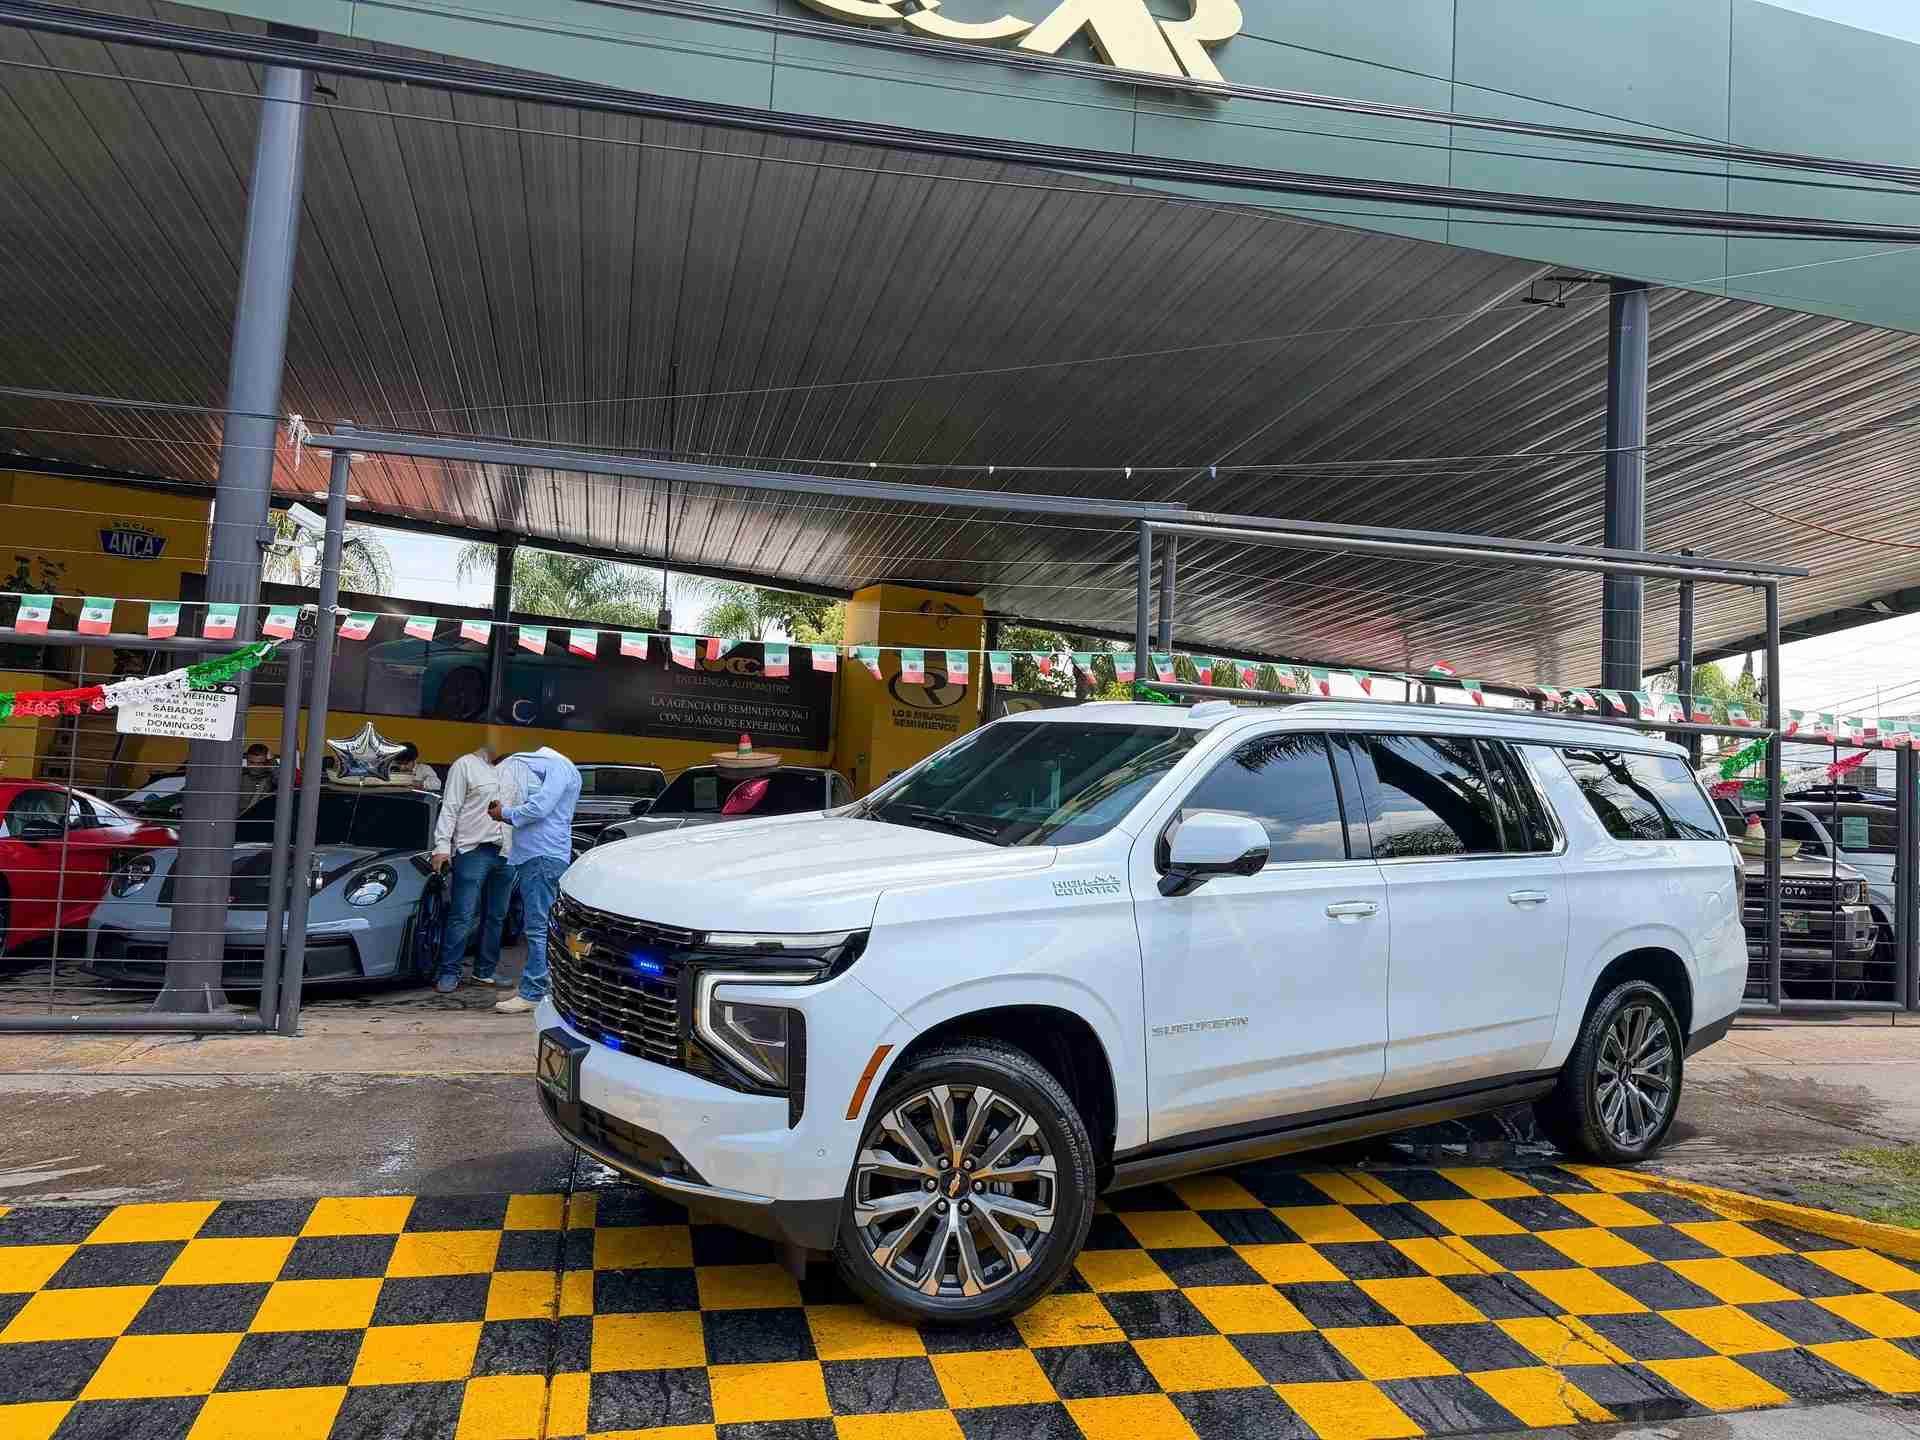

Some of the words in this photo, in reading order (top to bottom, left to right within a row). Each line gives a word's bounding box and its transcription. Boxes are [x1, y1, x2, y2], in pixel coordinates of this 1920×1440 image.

[182, 690, 227, 703] VIERNES
[651, 695, 665, 708] LA
[667, 698, 712, 712] AGENCIA
[713, 701, 727, 713] DE
[147, 719, 206, 732] DOMINGOS
[659, 712, 681, 723] CON
[724, 717, 737, 728] DE
